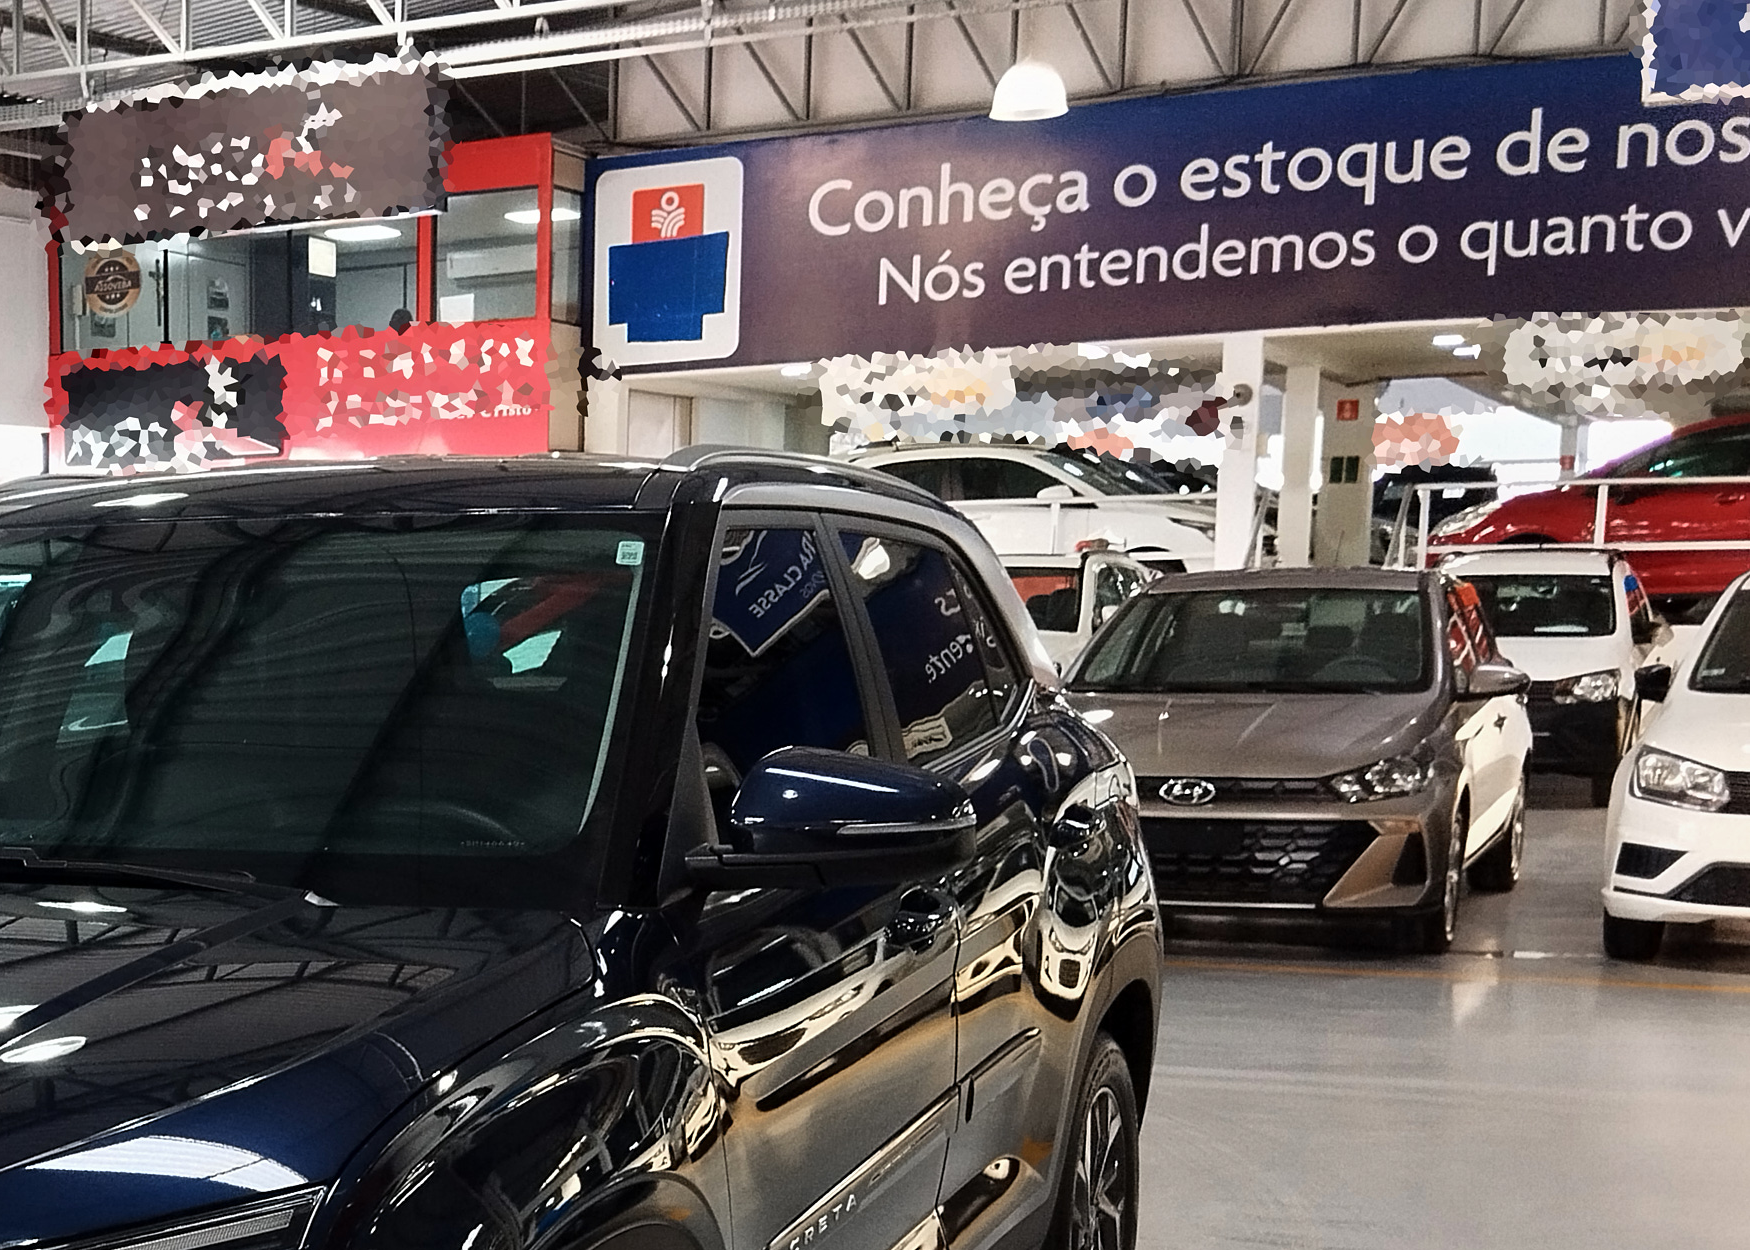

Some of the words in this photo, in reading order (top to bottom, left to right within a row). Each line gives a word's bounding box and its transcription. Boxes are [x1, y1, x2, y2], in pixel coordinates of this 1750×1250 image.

[809, 163, 1090, 236] Conheça
[1113, 164, 1156, 207] o
[1180, 137, 1471, 205] estoque
[1496, 108, 1590, 176] de
[878, 248, 986, 306] Nós
[1004, 225, 1376, 294] entendemos
[1398, 225, 1438, 263] o
[1460, 204, 1693, 276] quanto
